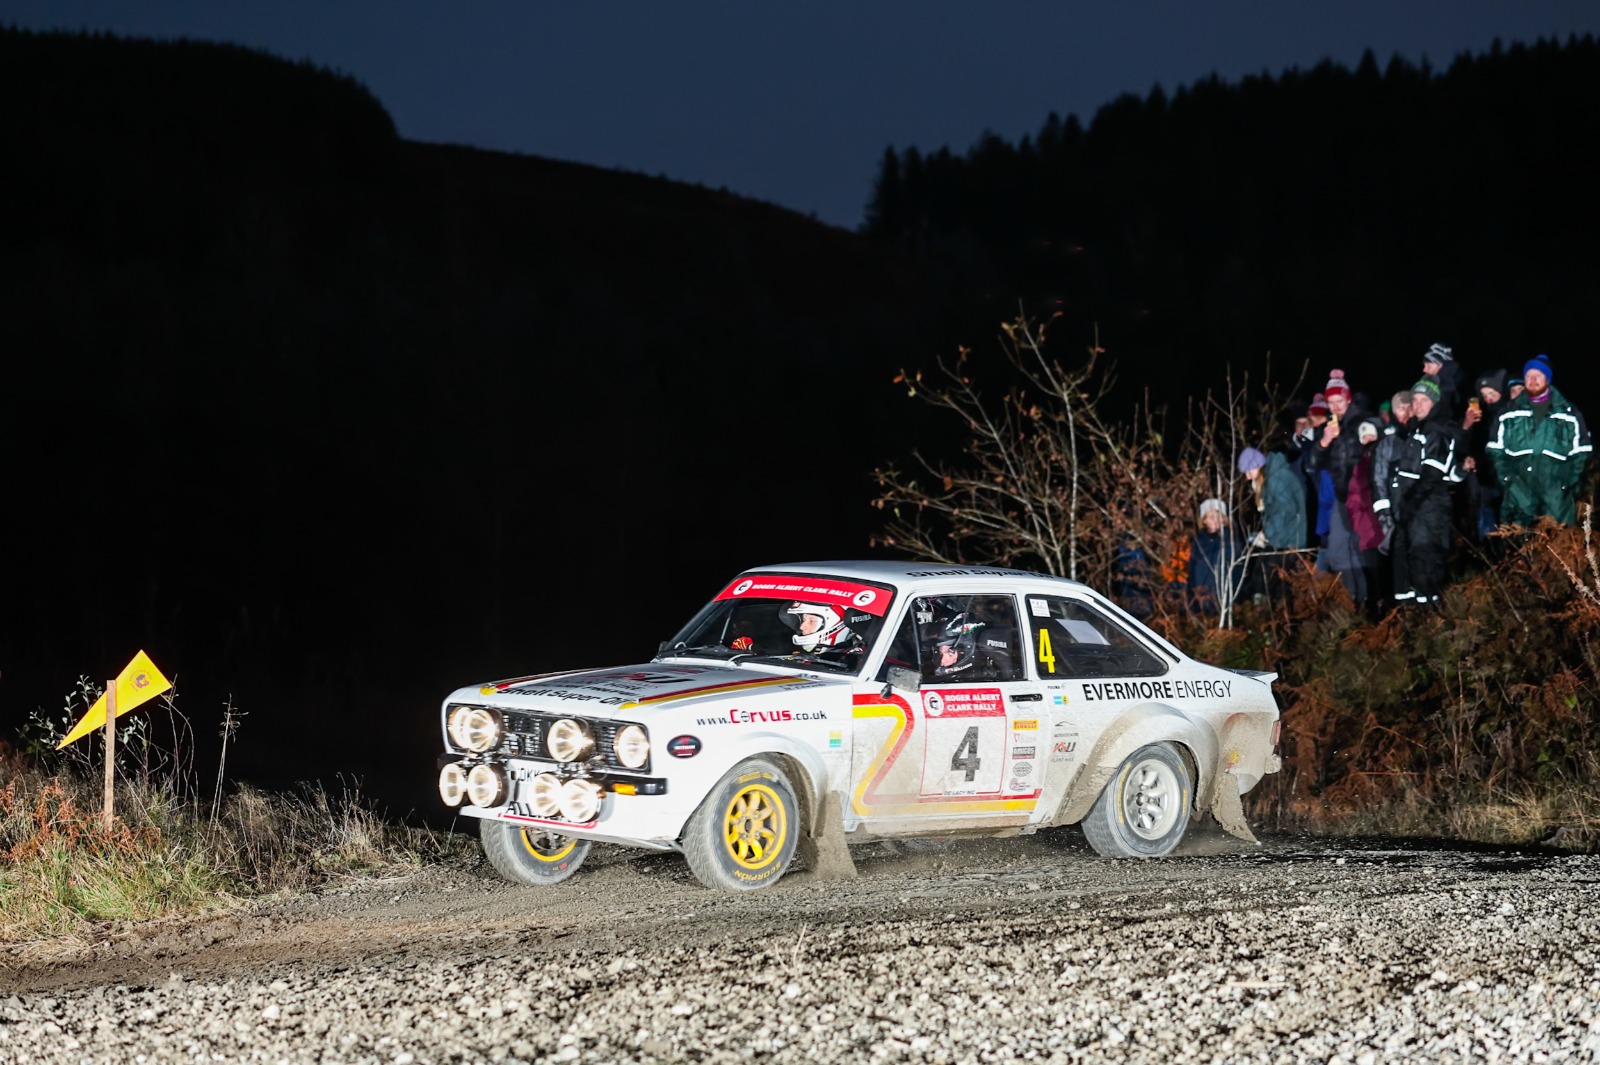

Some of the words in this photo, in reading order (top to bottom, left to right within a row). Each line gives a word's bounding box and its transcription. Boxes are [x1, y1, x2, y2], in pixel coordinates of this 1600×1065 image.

[906, 569, 969, 578] Shell
[970, 569, 1026, 577] Super
[752, 583, 775, 591] ROGER
[776, 584, 804, 592] ALBERT
[803, 586, 828, 595] CLARK
[827, 589, 855, 598] RALLY
[1038, 628, 1056, 674] 4
[496, 687, 550, 697] Shell
[551, 689, 600, 702] Super
[600, 696, 630, 706] Oil
[972, 693, 1001, 701] ALBERT
[1081, 681, 1174, 701] EVERMORE
[1175, 680, 1232, 698] ENERGY
[946, 703, 972, 712] CLARK
[973, 703, 997, 711] RALLY
[951, 726, 982, 782] 4
[733, 861, 782, 881] SCORPION
